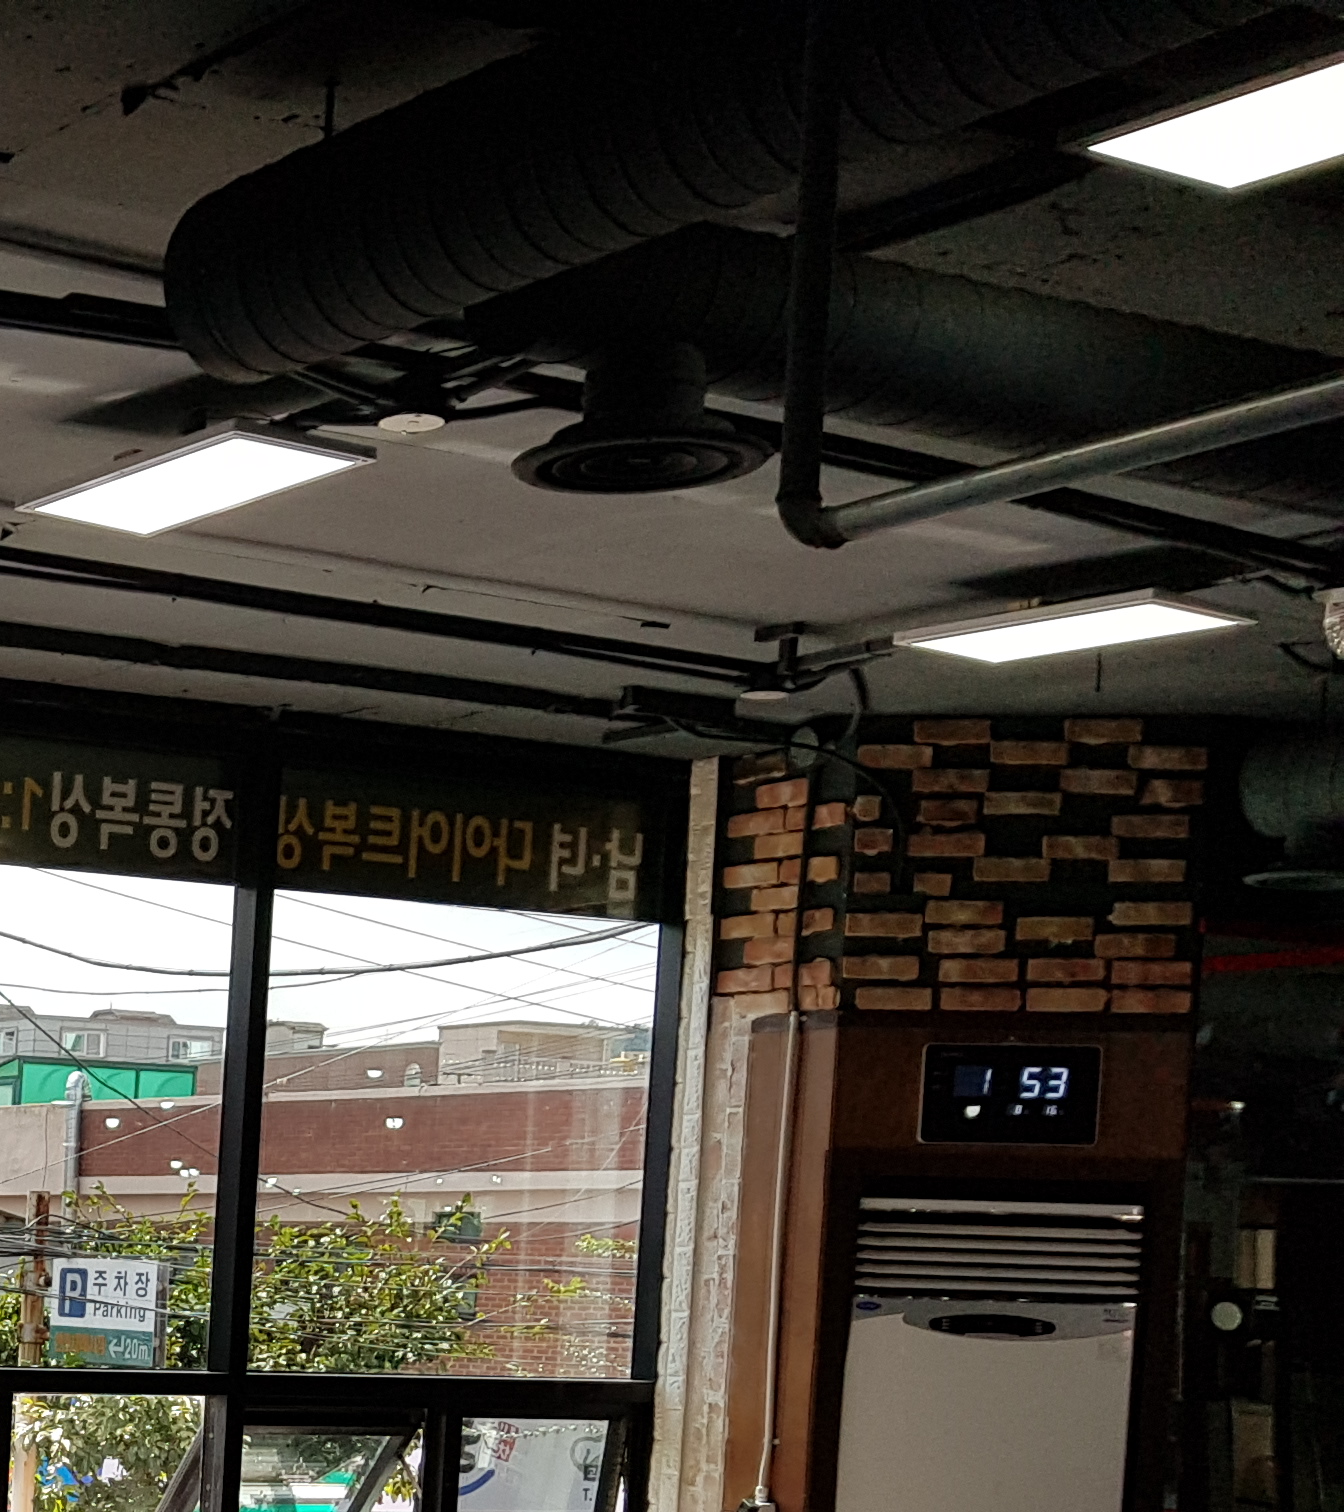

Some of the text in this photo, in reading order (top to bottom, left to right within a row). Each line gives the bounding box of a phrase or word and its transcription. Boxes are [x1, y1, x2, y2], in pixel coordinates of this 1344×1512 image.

[1020, 1067, 1069, 1098] 53
[92, 1269, 151, 1298] 주차장
[93, 1301, 147, 1323] Parking
